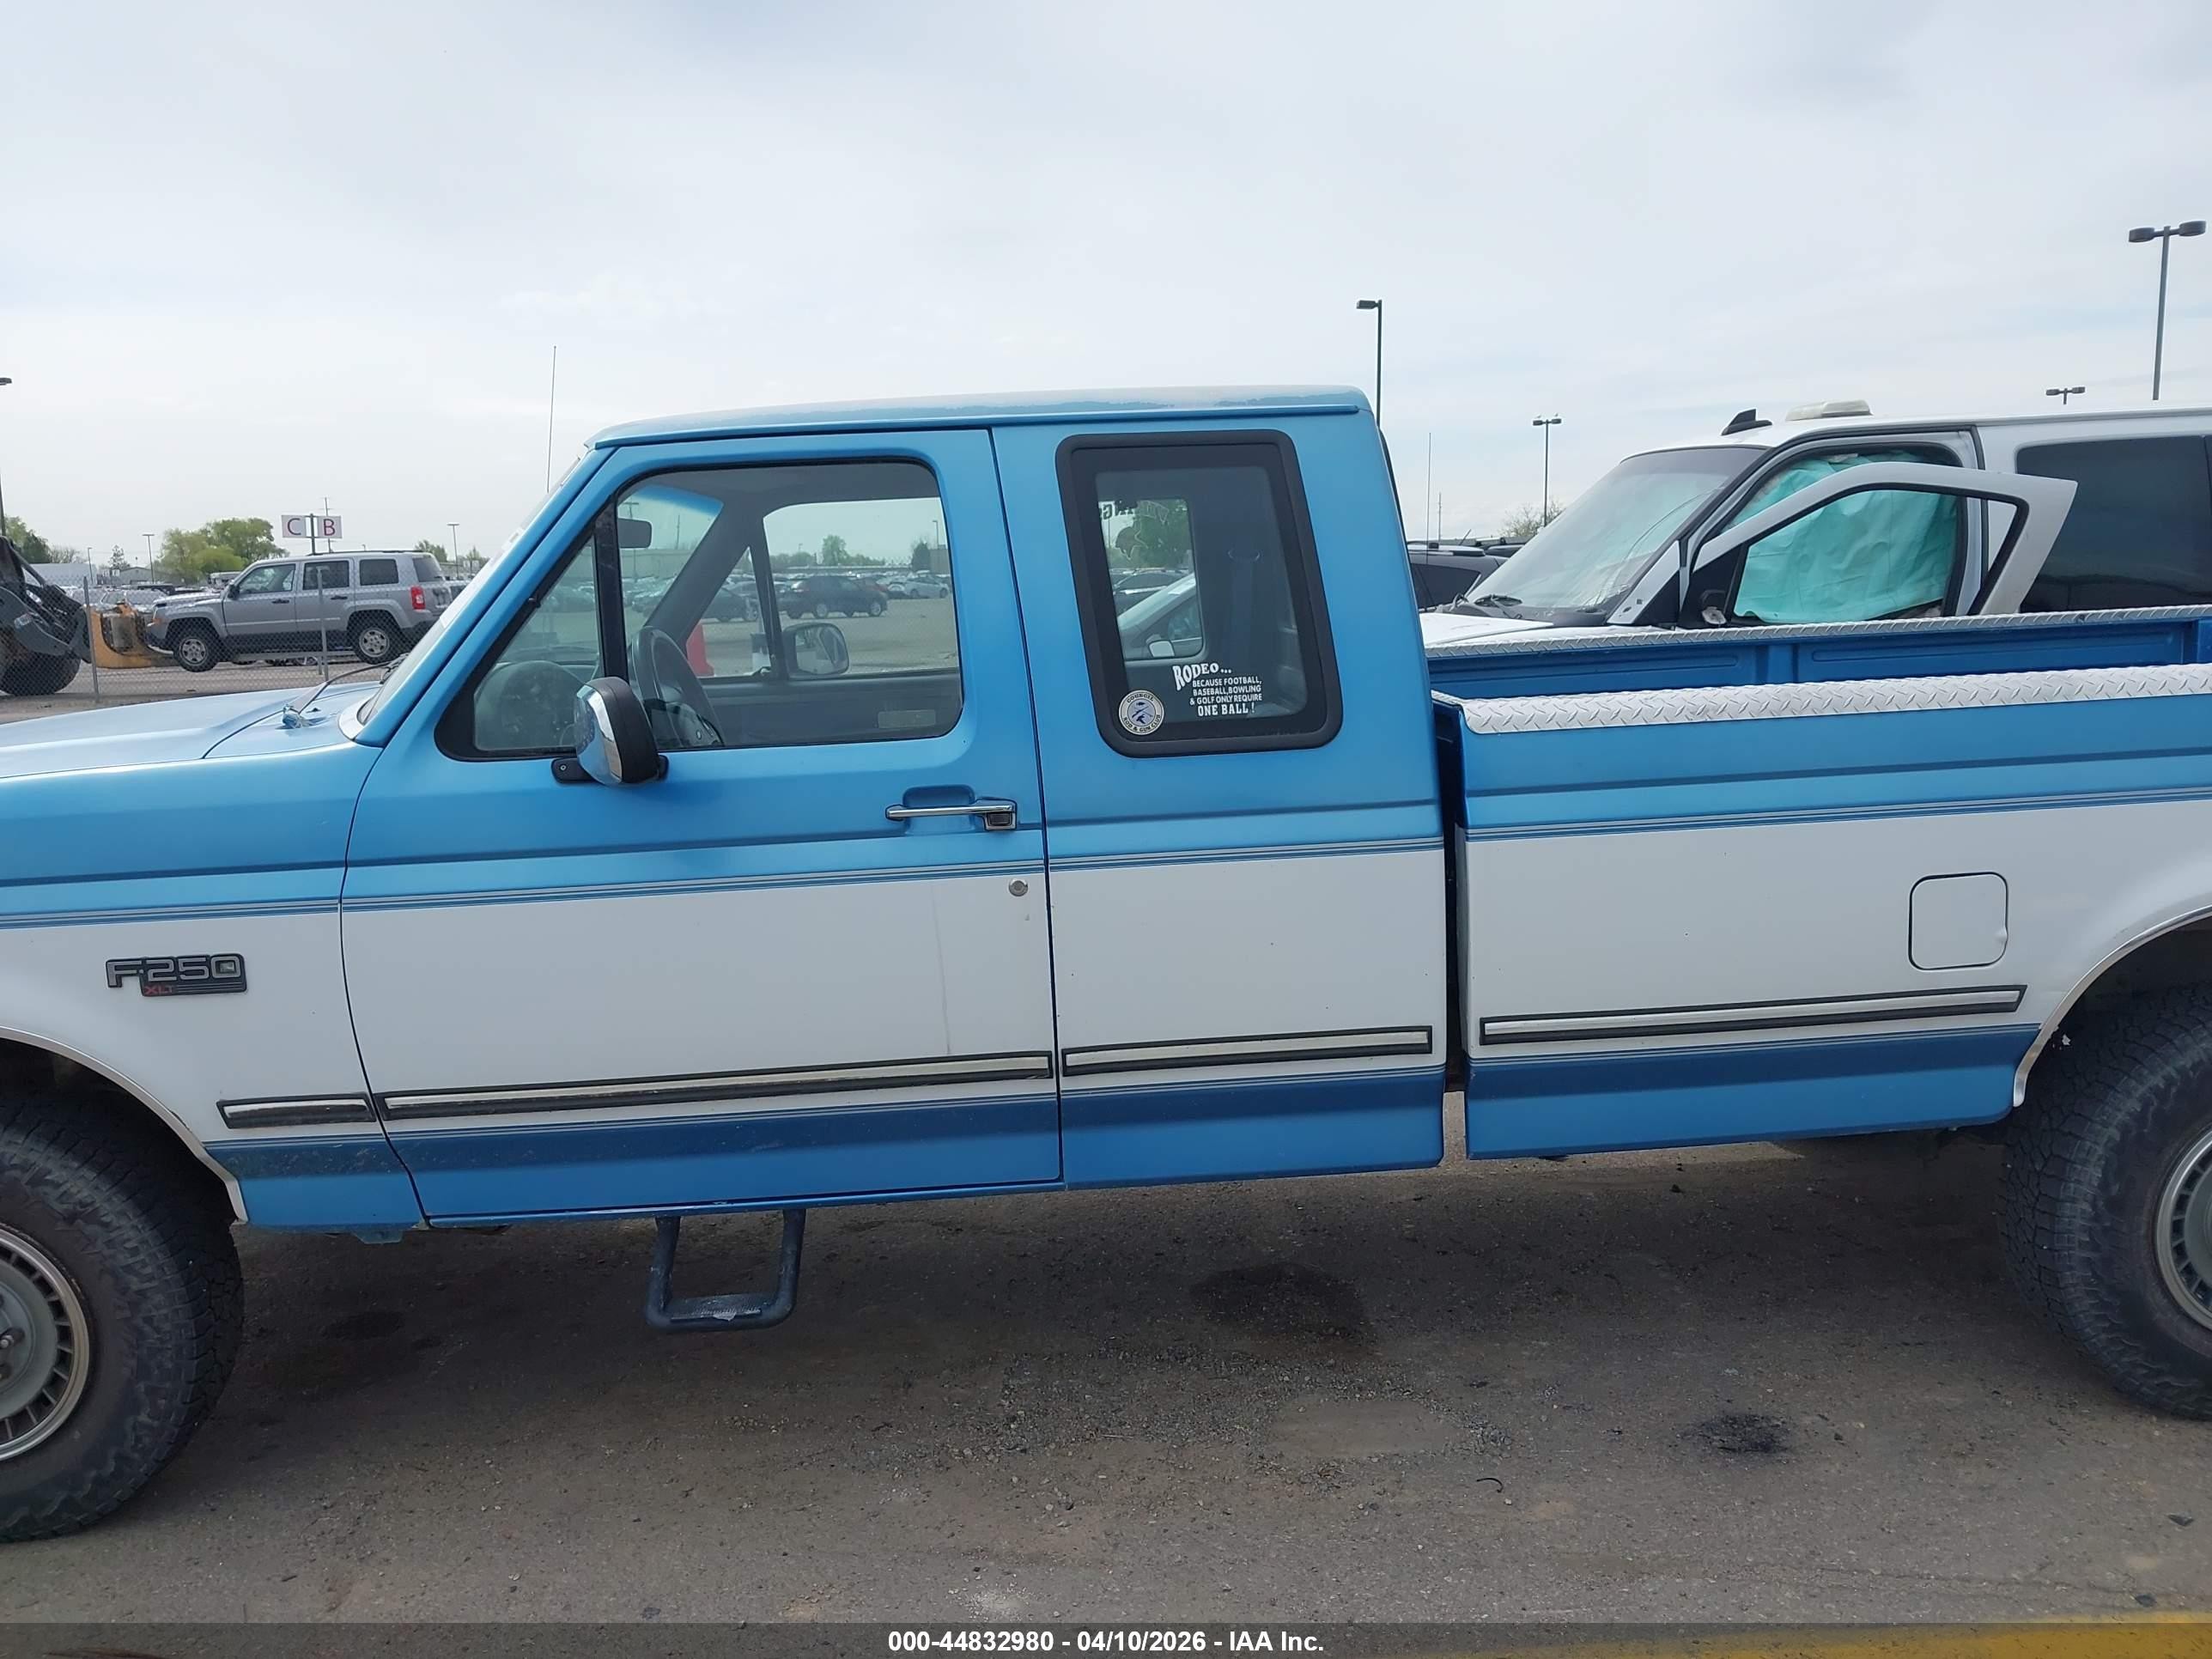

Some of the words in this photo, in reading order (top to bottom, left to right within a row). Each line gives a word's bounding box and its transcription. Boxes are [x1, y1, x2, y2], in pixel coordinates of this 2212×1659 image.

[287, 517, 302, 536] C
[323, 518, 336, 537] B
[1192, 678, 1223, 688] BECAUSE
[1224, 676, 1262, 685] FOOTBALL,
[1127, 693, 1154, 703] COUNCIL
[1189, 697, 1195, 706] &
[1196, 696, 1215, 705] GOLF
[1215, 695, 1233, 703] ONLY
[1233, 693, 1262, 702] REQUIRE
[1197, 704, 1218, 717] ONE
